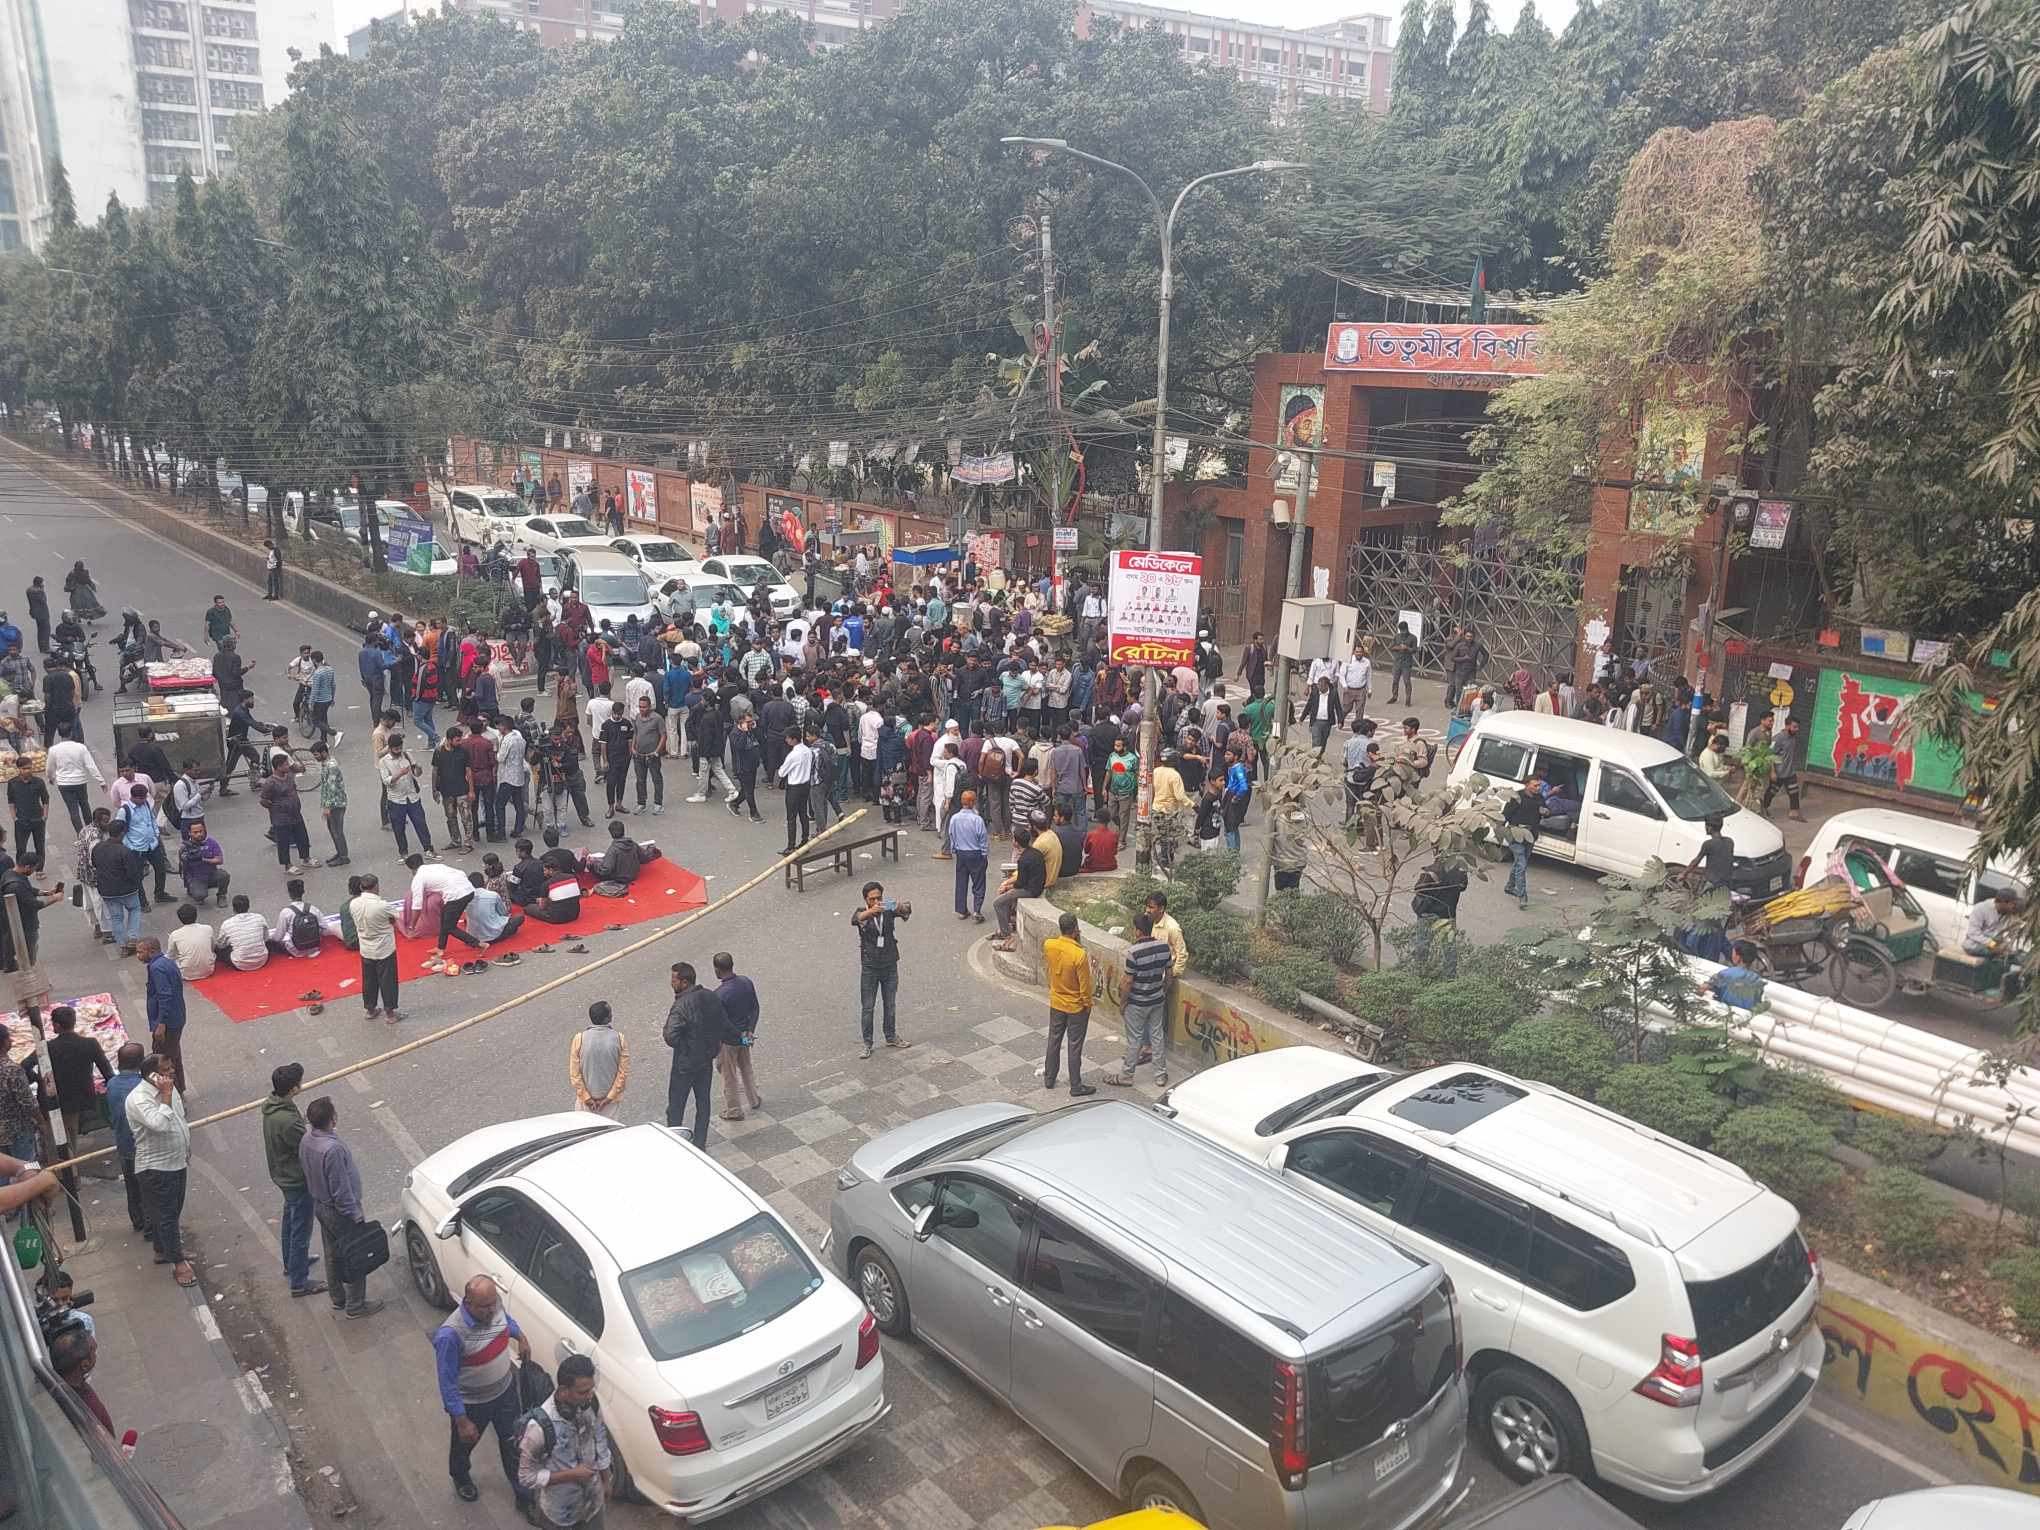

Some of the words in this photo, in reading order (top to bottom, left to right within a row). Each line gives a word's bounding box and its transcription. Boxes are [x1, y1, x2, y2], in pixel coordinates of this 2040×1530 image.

[1367, 329, 1464, 367] তিতুমীর
[1470, 329, 1543, 362] বিশ্ববি
[1128, 554, 1194, 573] মেডিকেলে
[1112, 641, 1192, 662] রেটিনা
